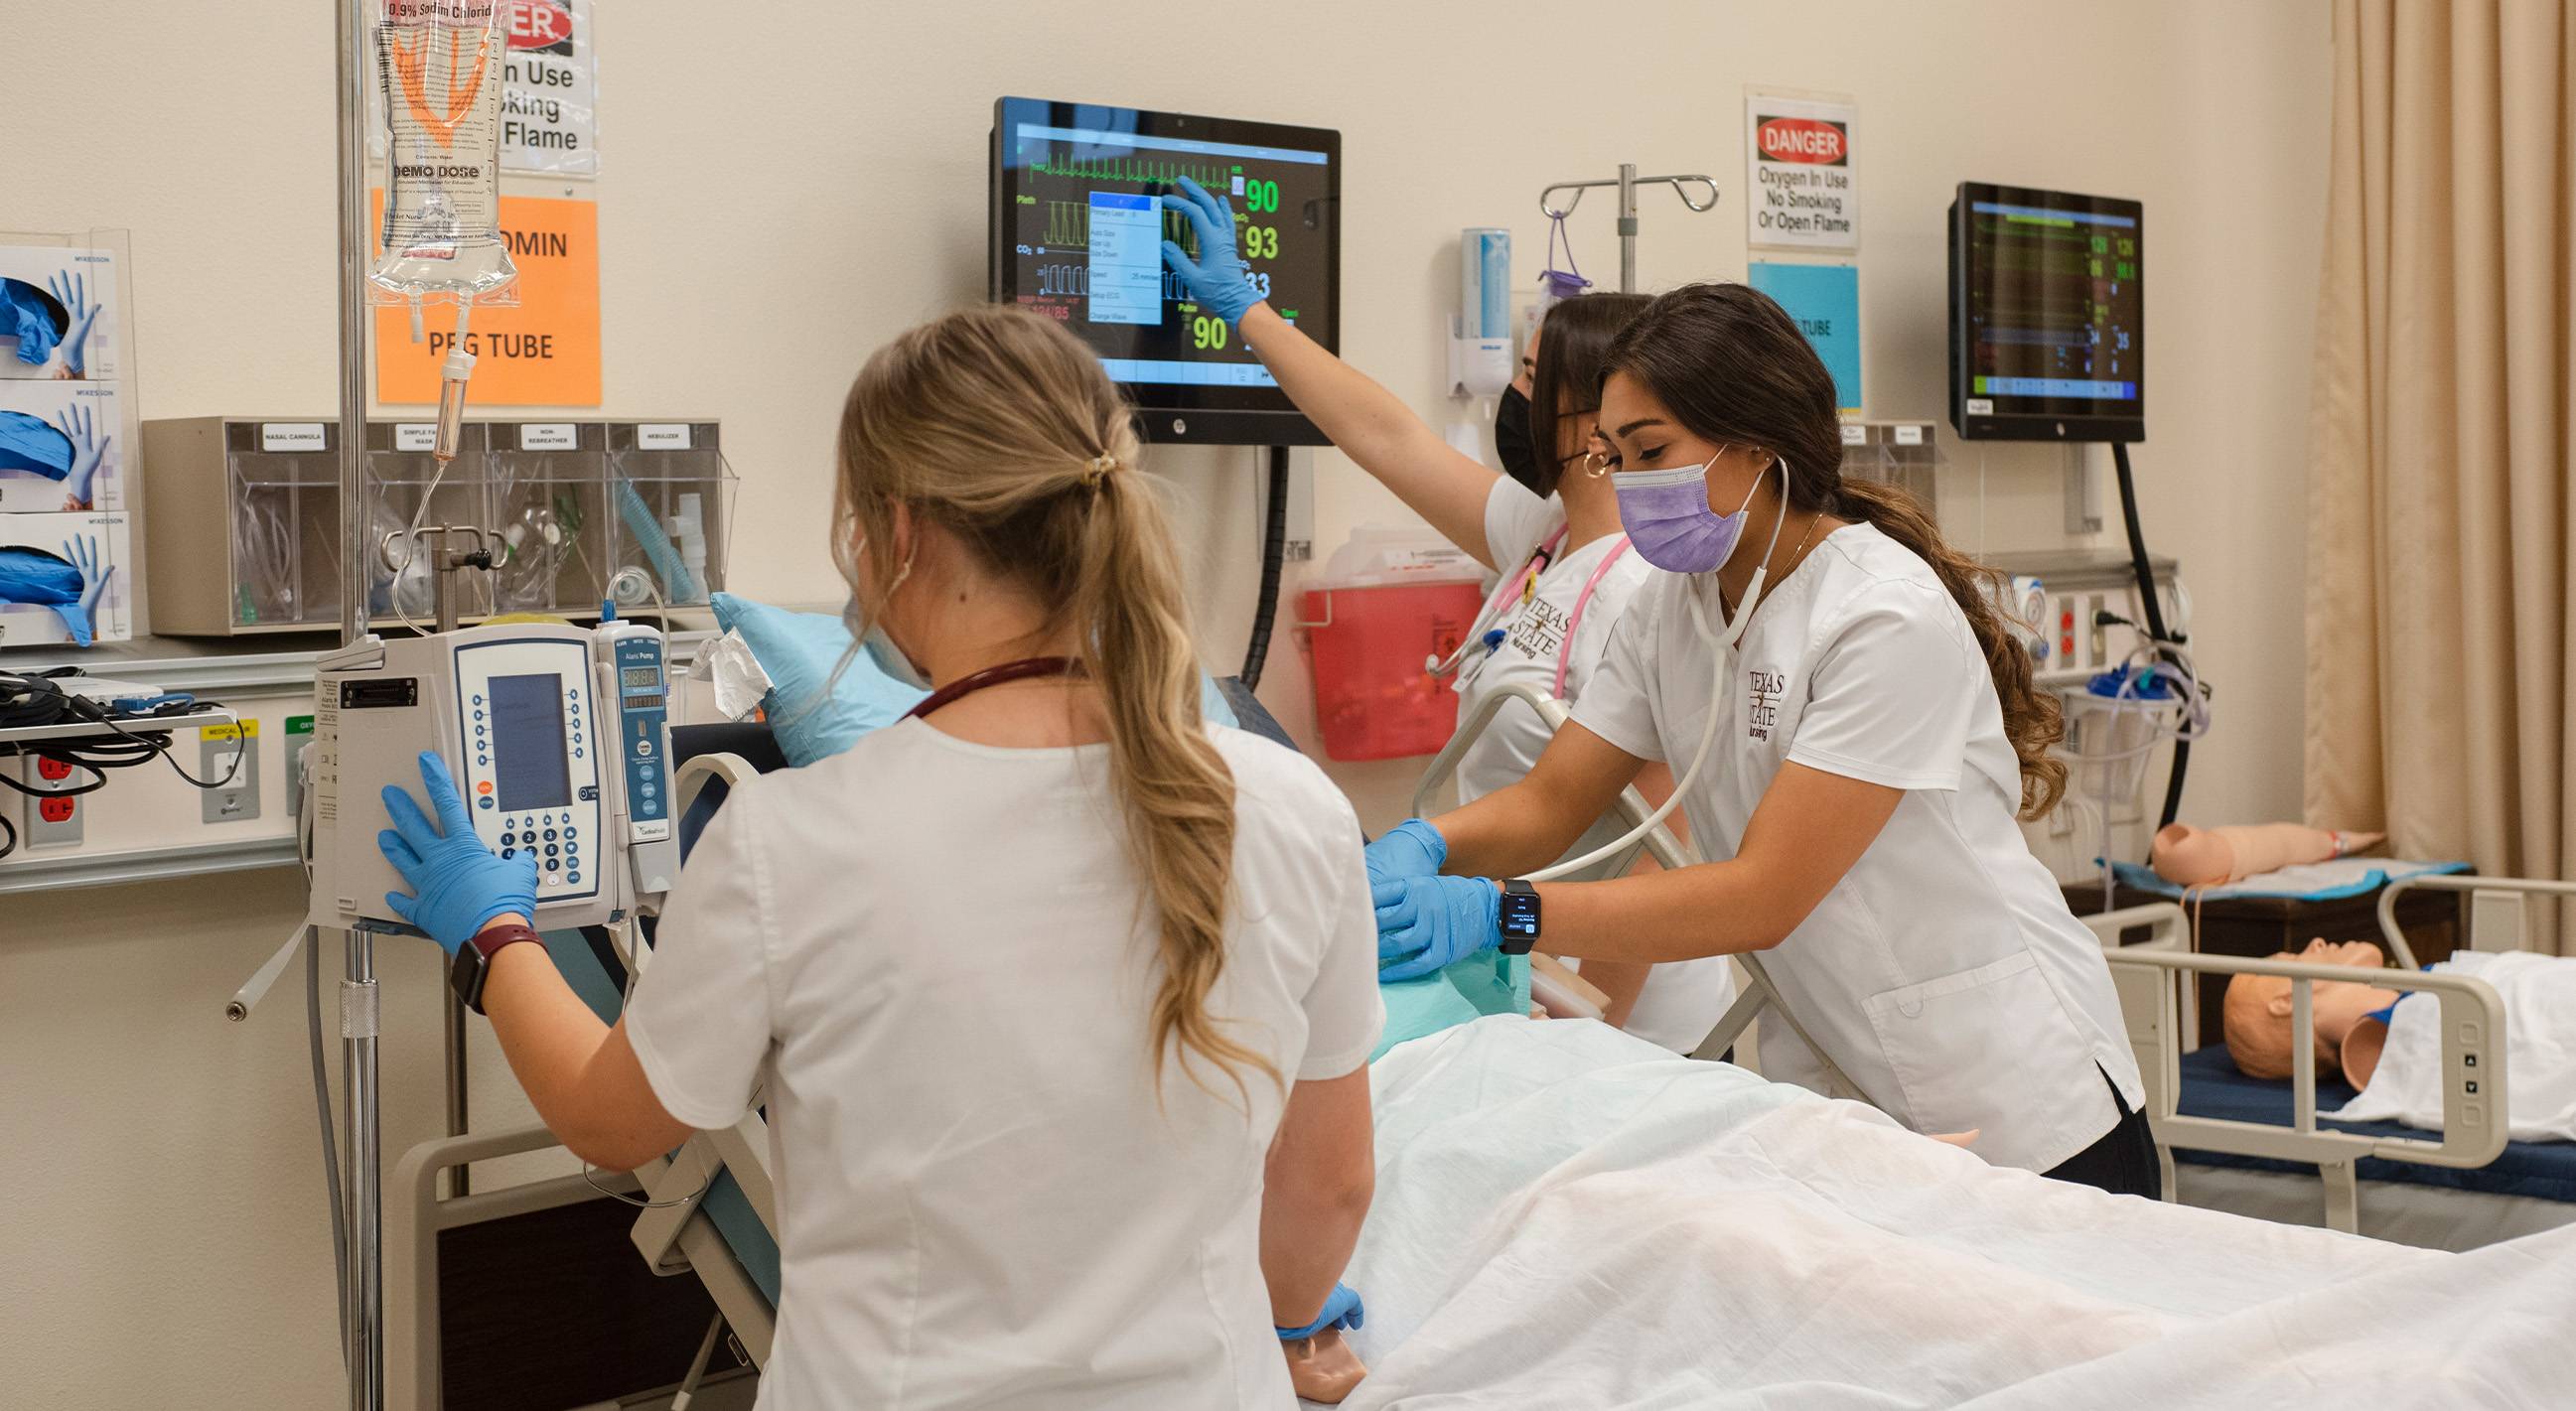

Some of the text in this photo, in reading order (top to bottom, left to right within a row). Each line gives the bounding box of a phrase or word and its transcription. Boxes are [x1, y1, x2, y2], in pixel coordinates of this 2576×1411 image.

[388, 3, 416, 18] 0.9%
[452, 5, 492, 19] Chlorid
[528, 62, 574, 87] Use
[501, 90, 560, 123] king
[504, 121, 578, 150] Flame
[1765, 127, 1841, 157] DANGER
[1759, 166, 1848, 189] Oxygen In Use
[1246, 180, 1279, 212] 90
[1767, 189, 1842, 214] No Smoking
[1758, 211, 1850, 233] Or Open Flame
[1245, 225, 1278, 259] 93
[1194, 317, 1226, 350] 90
[1802, 319, 1831, 336] TUBE
[488, 333, 553, 358] TUBE
[1530, 597, 1572, 633] TEXAS
[1512, 636, 1536, 660] Nursing
[1513, 621, 1557, 656] STATE
[1749, 671, 1785, 694] TEXAS
[1750, 704, 1776, 727] TATE
[209, 727, 237, 736] MEDICAL
